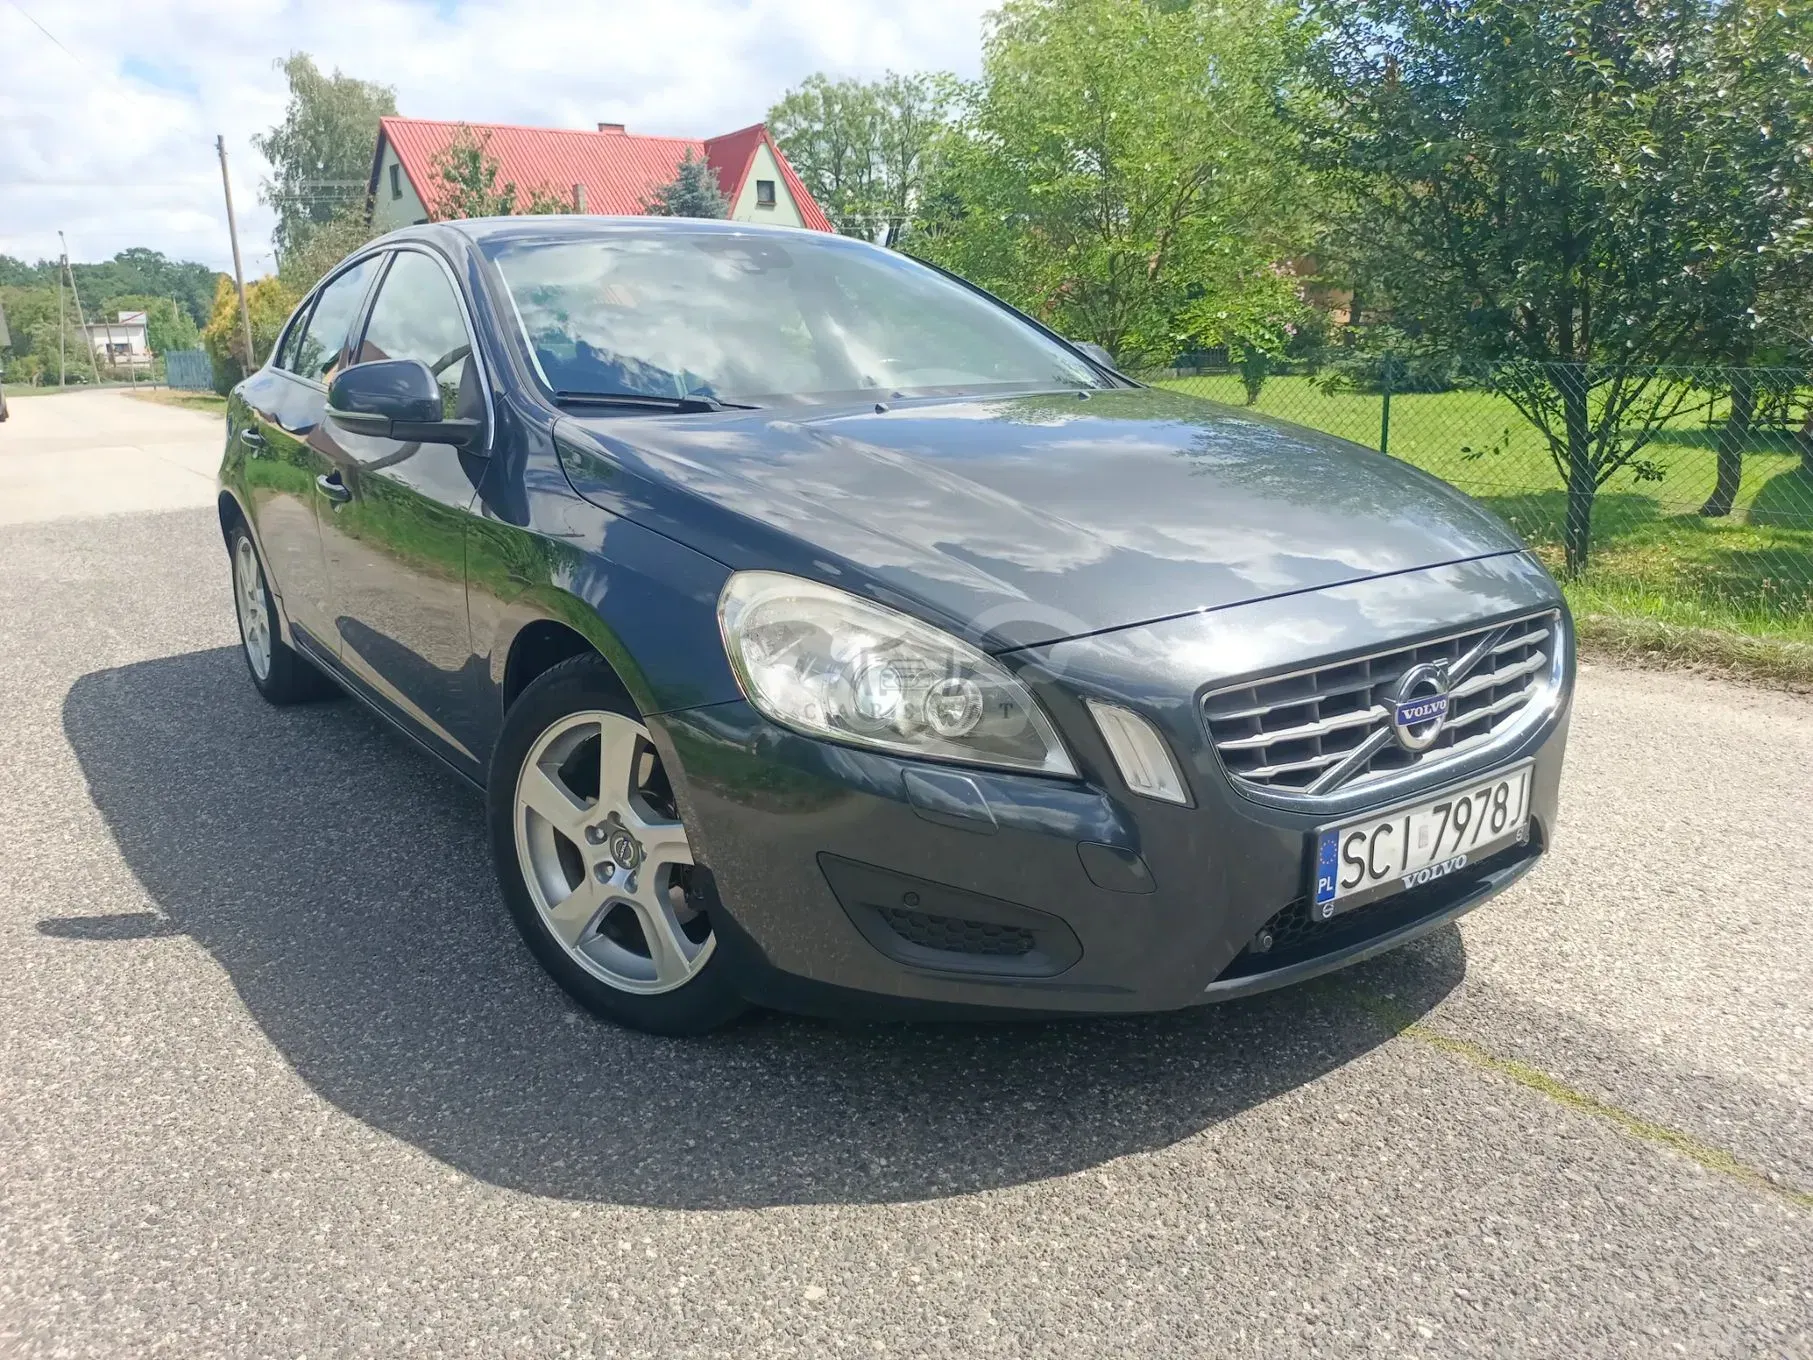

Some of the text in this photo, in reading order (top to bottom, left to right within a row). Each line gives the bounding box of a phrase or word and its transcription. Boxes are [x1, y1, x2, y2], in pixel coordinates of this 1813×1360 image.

[1401, 699, 1447, 720] VOLVO
[1341, 772, 1527, 890] SCI 7978J
[1401, 853, 1468, 889] VOLVO
[1317, 877, 1334, 894] PL
